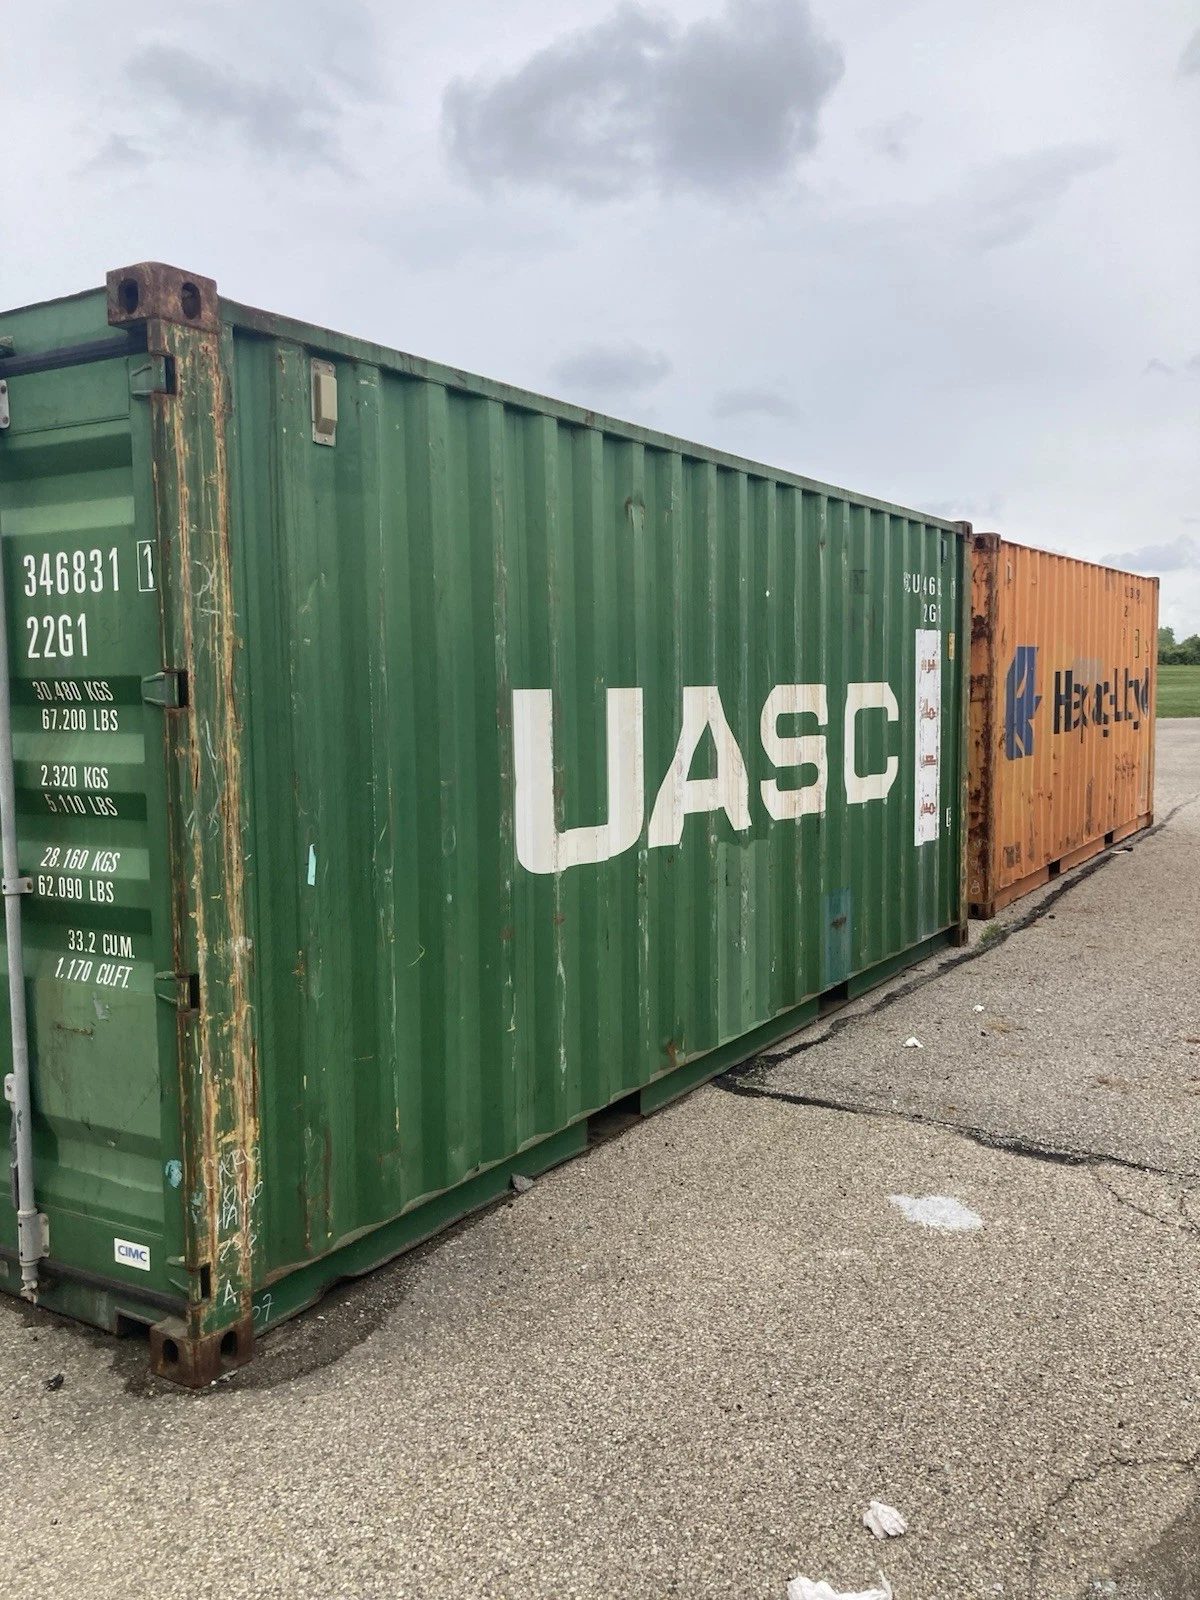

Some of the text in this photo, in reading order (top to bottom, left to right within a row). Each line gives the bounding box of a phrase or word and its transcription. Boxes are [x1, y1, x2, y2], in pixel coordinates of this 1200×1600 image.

[23, 547, 119, 597] 346831
[26, 613, 88, 659] 22G1
[32, 680, 114, 701] 30.480 KGS
[42, 708, 119, 731] 67.200 LBS
[40, 764, 109, 789] 2.320 KGS
[512, 682, 899, 875] UASC
[44, 793, 118, 816] 5.110 LBS
[40, 847, 121, 873] 28.160 KGS
[38, 875, 114, 903] 62.090 LBS
[68, 929, 96, 954] 33.2
[55, 957, 92, 982] 1.170
[117, 1245, 147, 1262] CIMC
